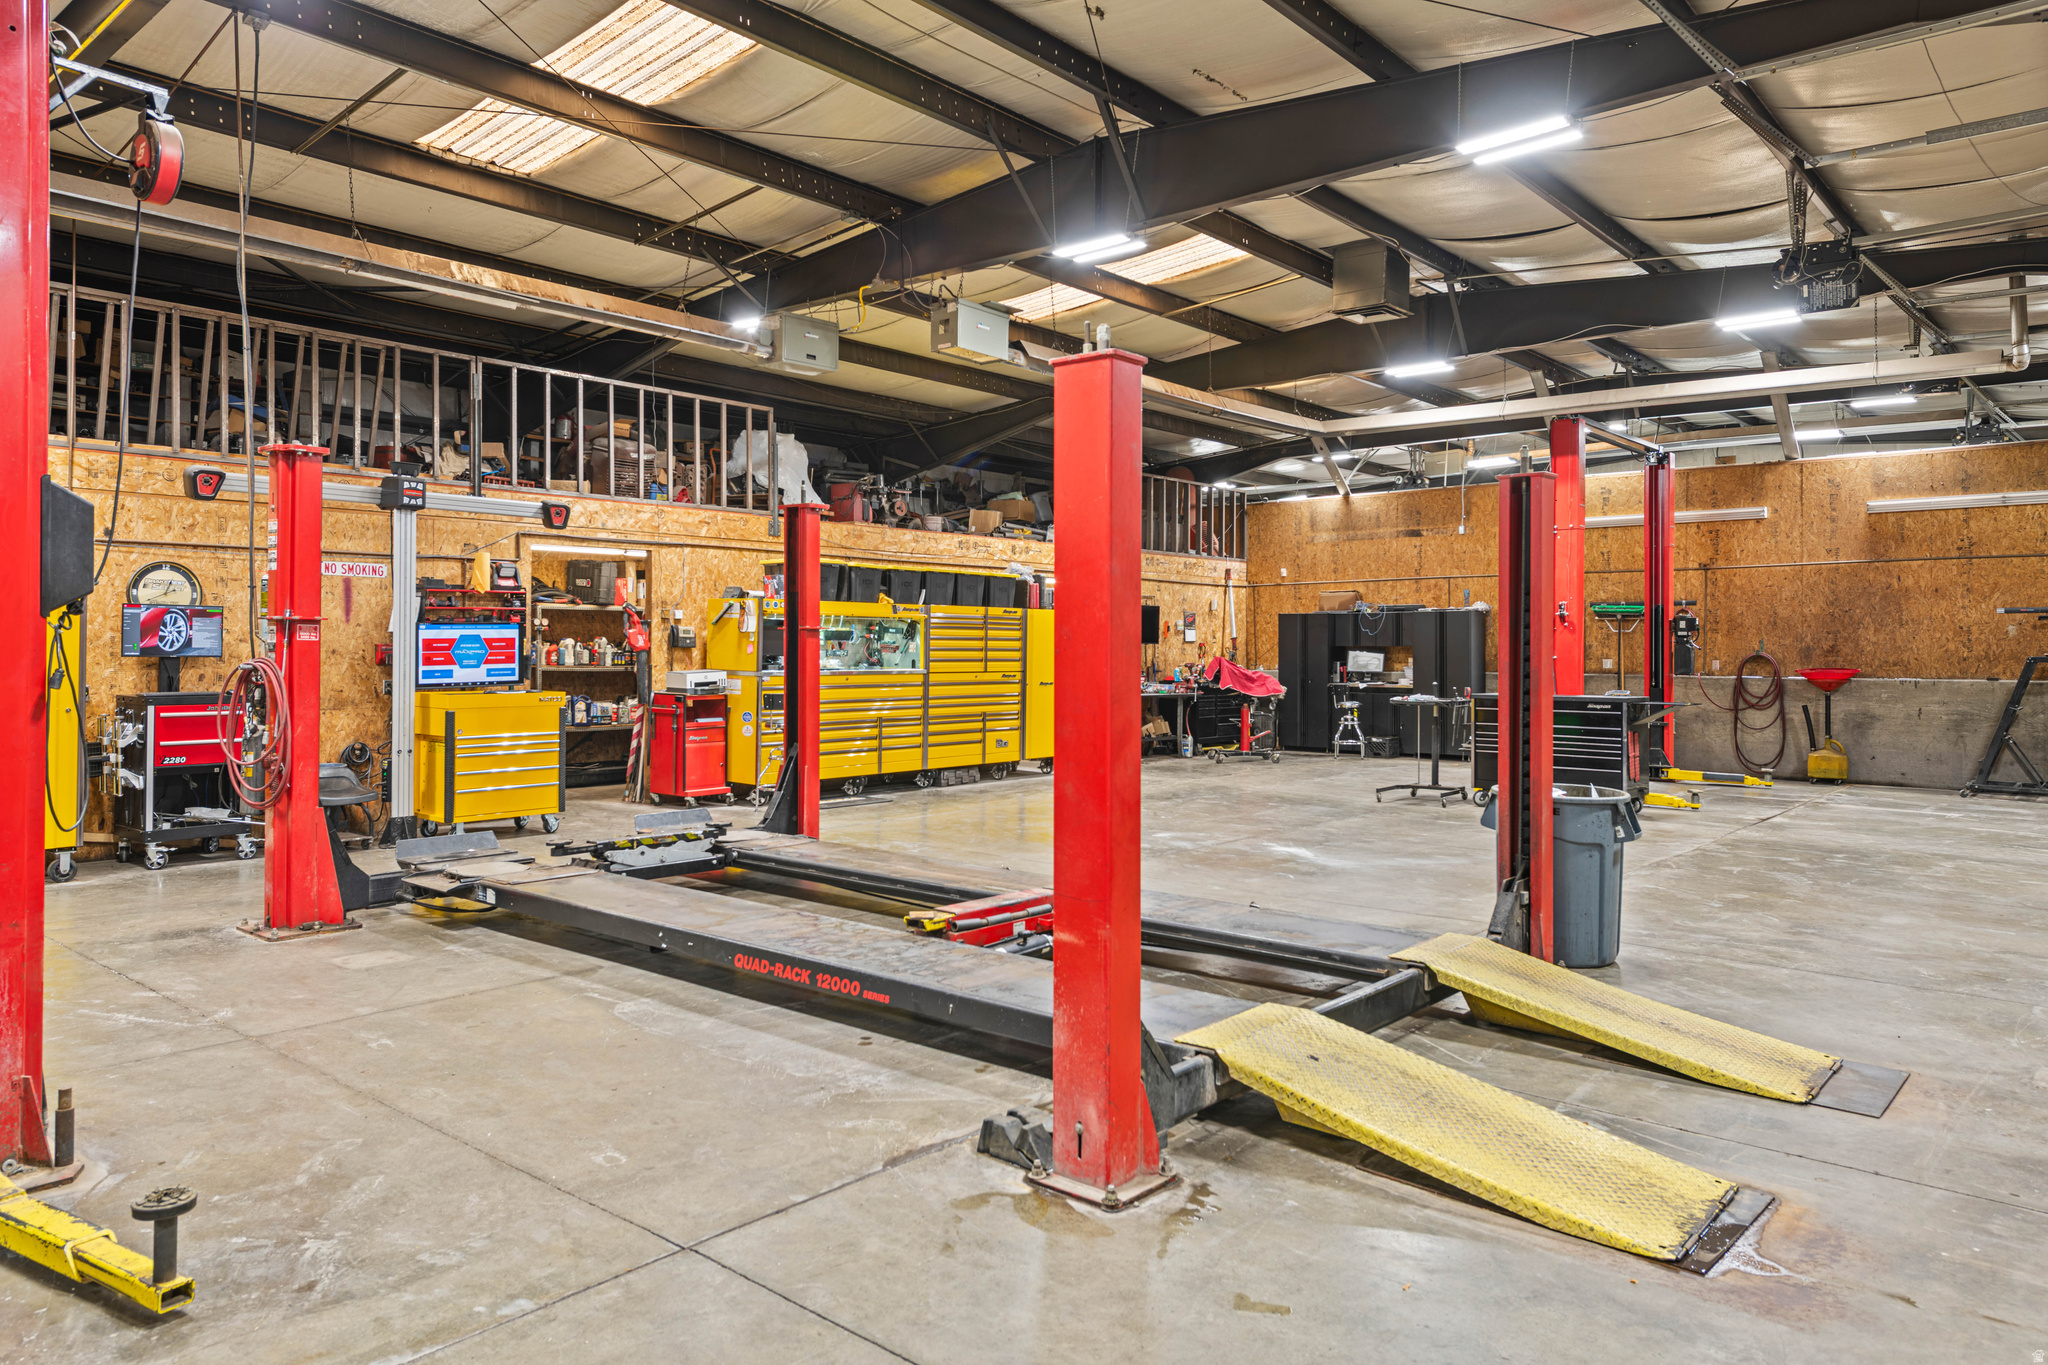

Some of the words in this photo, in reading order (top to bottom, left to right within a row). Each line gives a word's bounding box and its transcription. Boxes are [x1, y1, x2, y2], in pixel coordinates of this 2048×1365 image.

[324, 562, 337, 574] NO
[341, 563, 384, 577] SMOKING
[733, 953, 812, 985] QUAD-RACK
[816, 972, 861, 997] 12000
[862, 989, 890, 1004] SERIES
